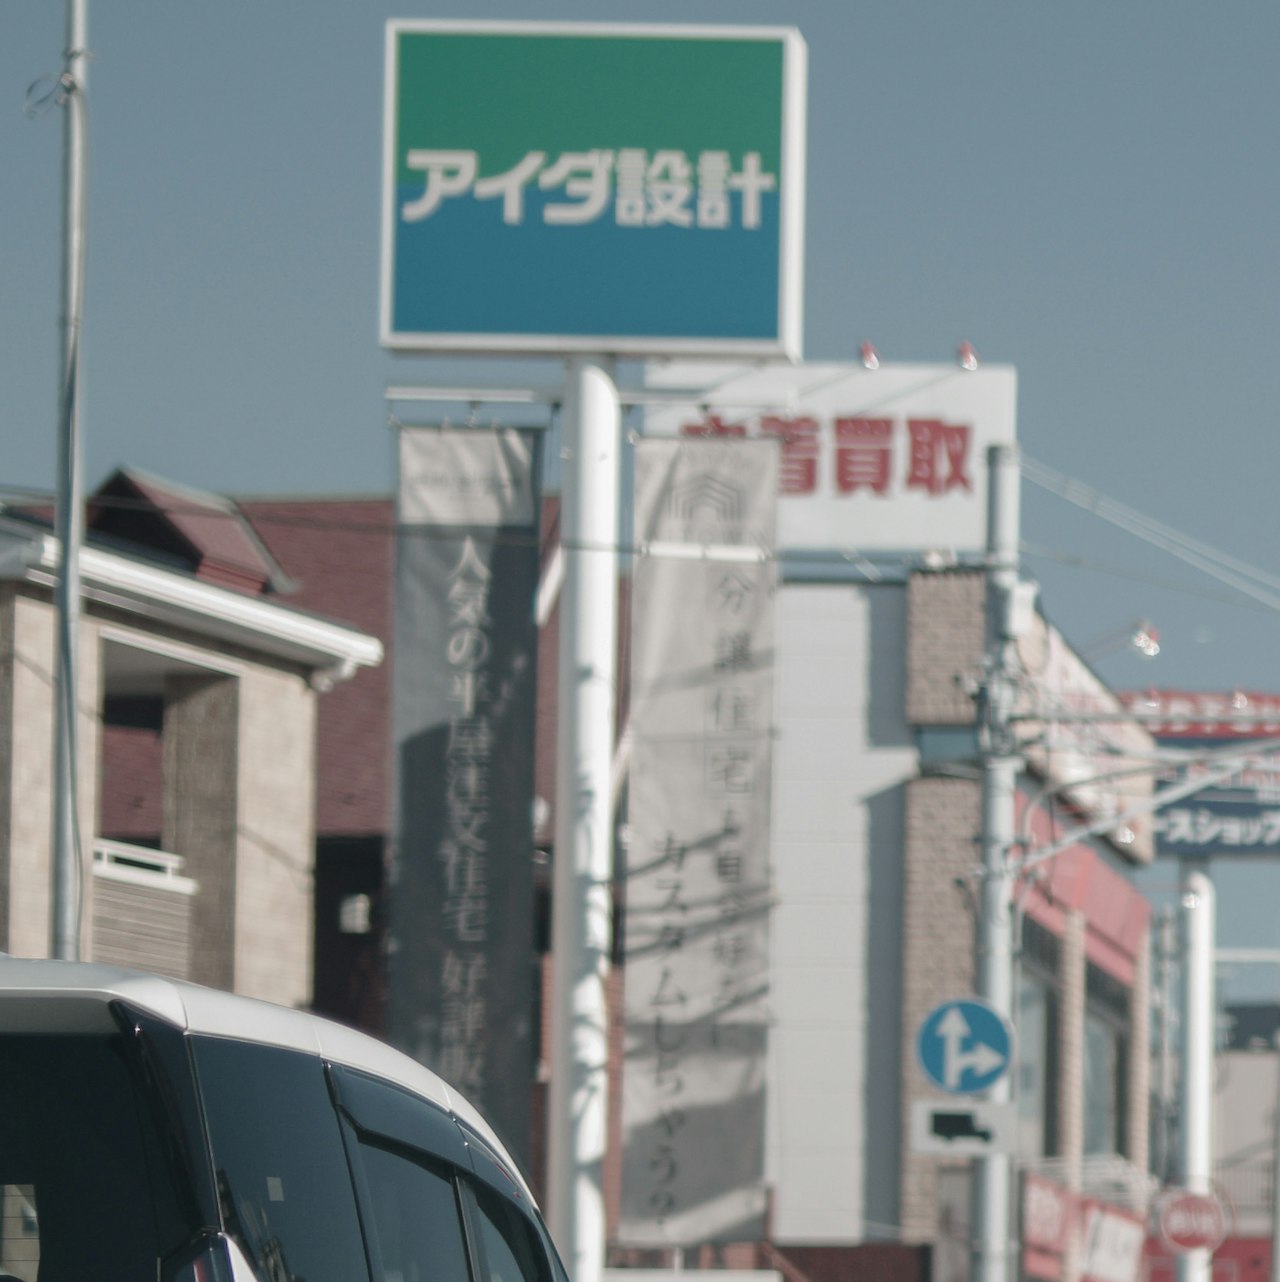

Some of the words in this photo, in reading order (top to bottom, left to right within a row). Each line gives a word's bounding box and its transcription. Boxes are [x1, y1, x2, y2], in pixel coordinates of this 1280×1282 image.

[402, 147, 774, 228] アイダ設計
[679, 413, 974, 498] 着買取
